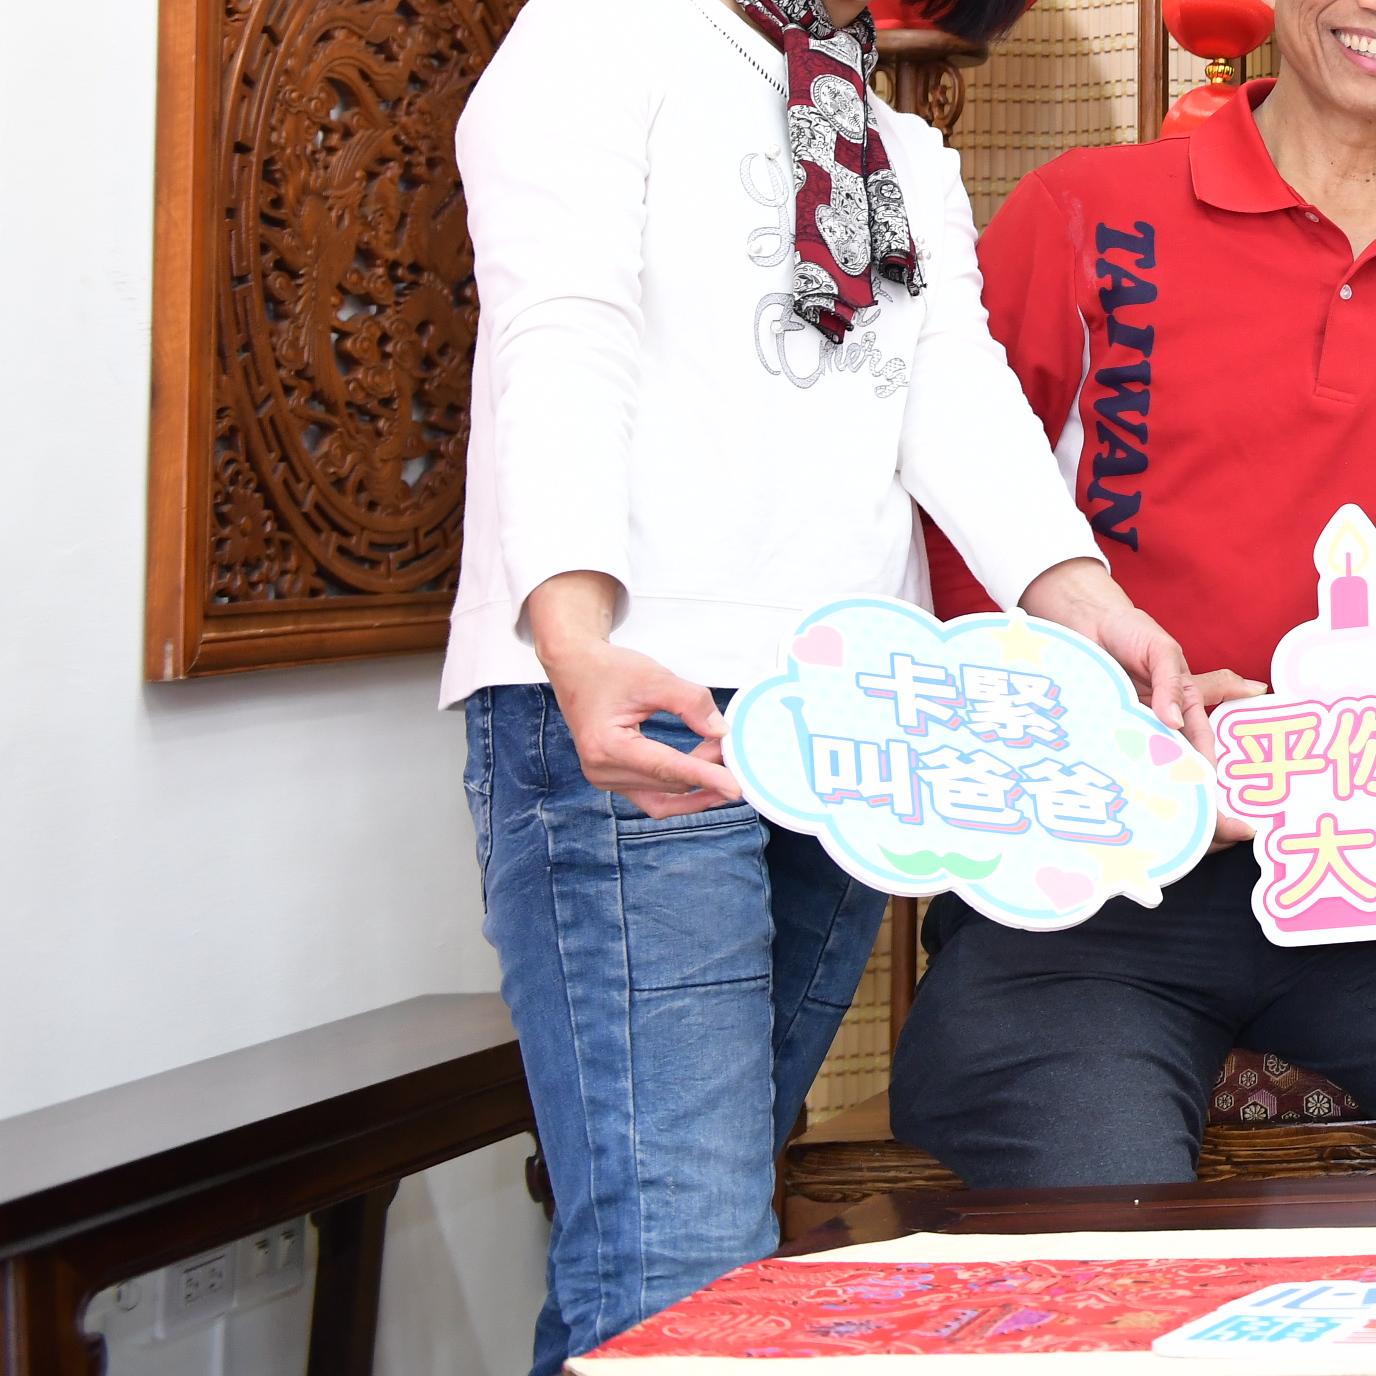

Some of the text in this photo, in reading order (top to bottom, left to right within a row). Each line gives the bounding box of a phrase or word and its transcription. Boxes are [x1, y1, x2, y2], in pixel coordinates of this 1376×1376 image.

[1087, 221, 1158, 553] TAIWAN
[856, 653, 1070, 751] 卡緊
[809, 734, 1132, 845] 叫爸爸
